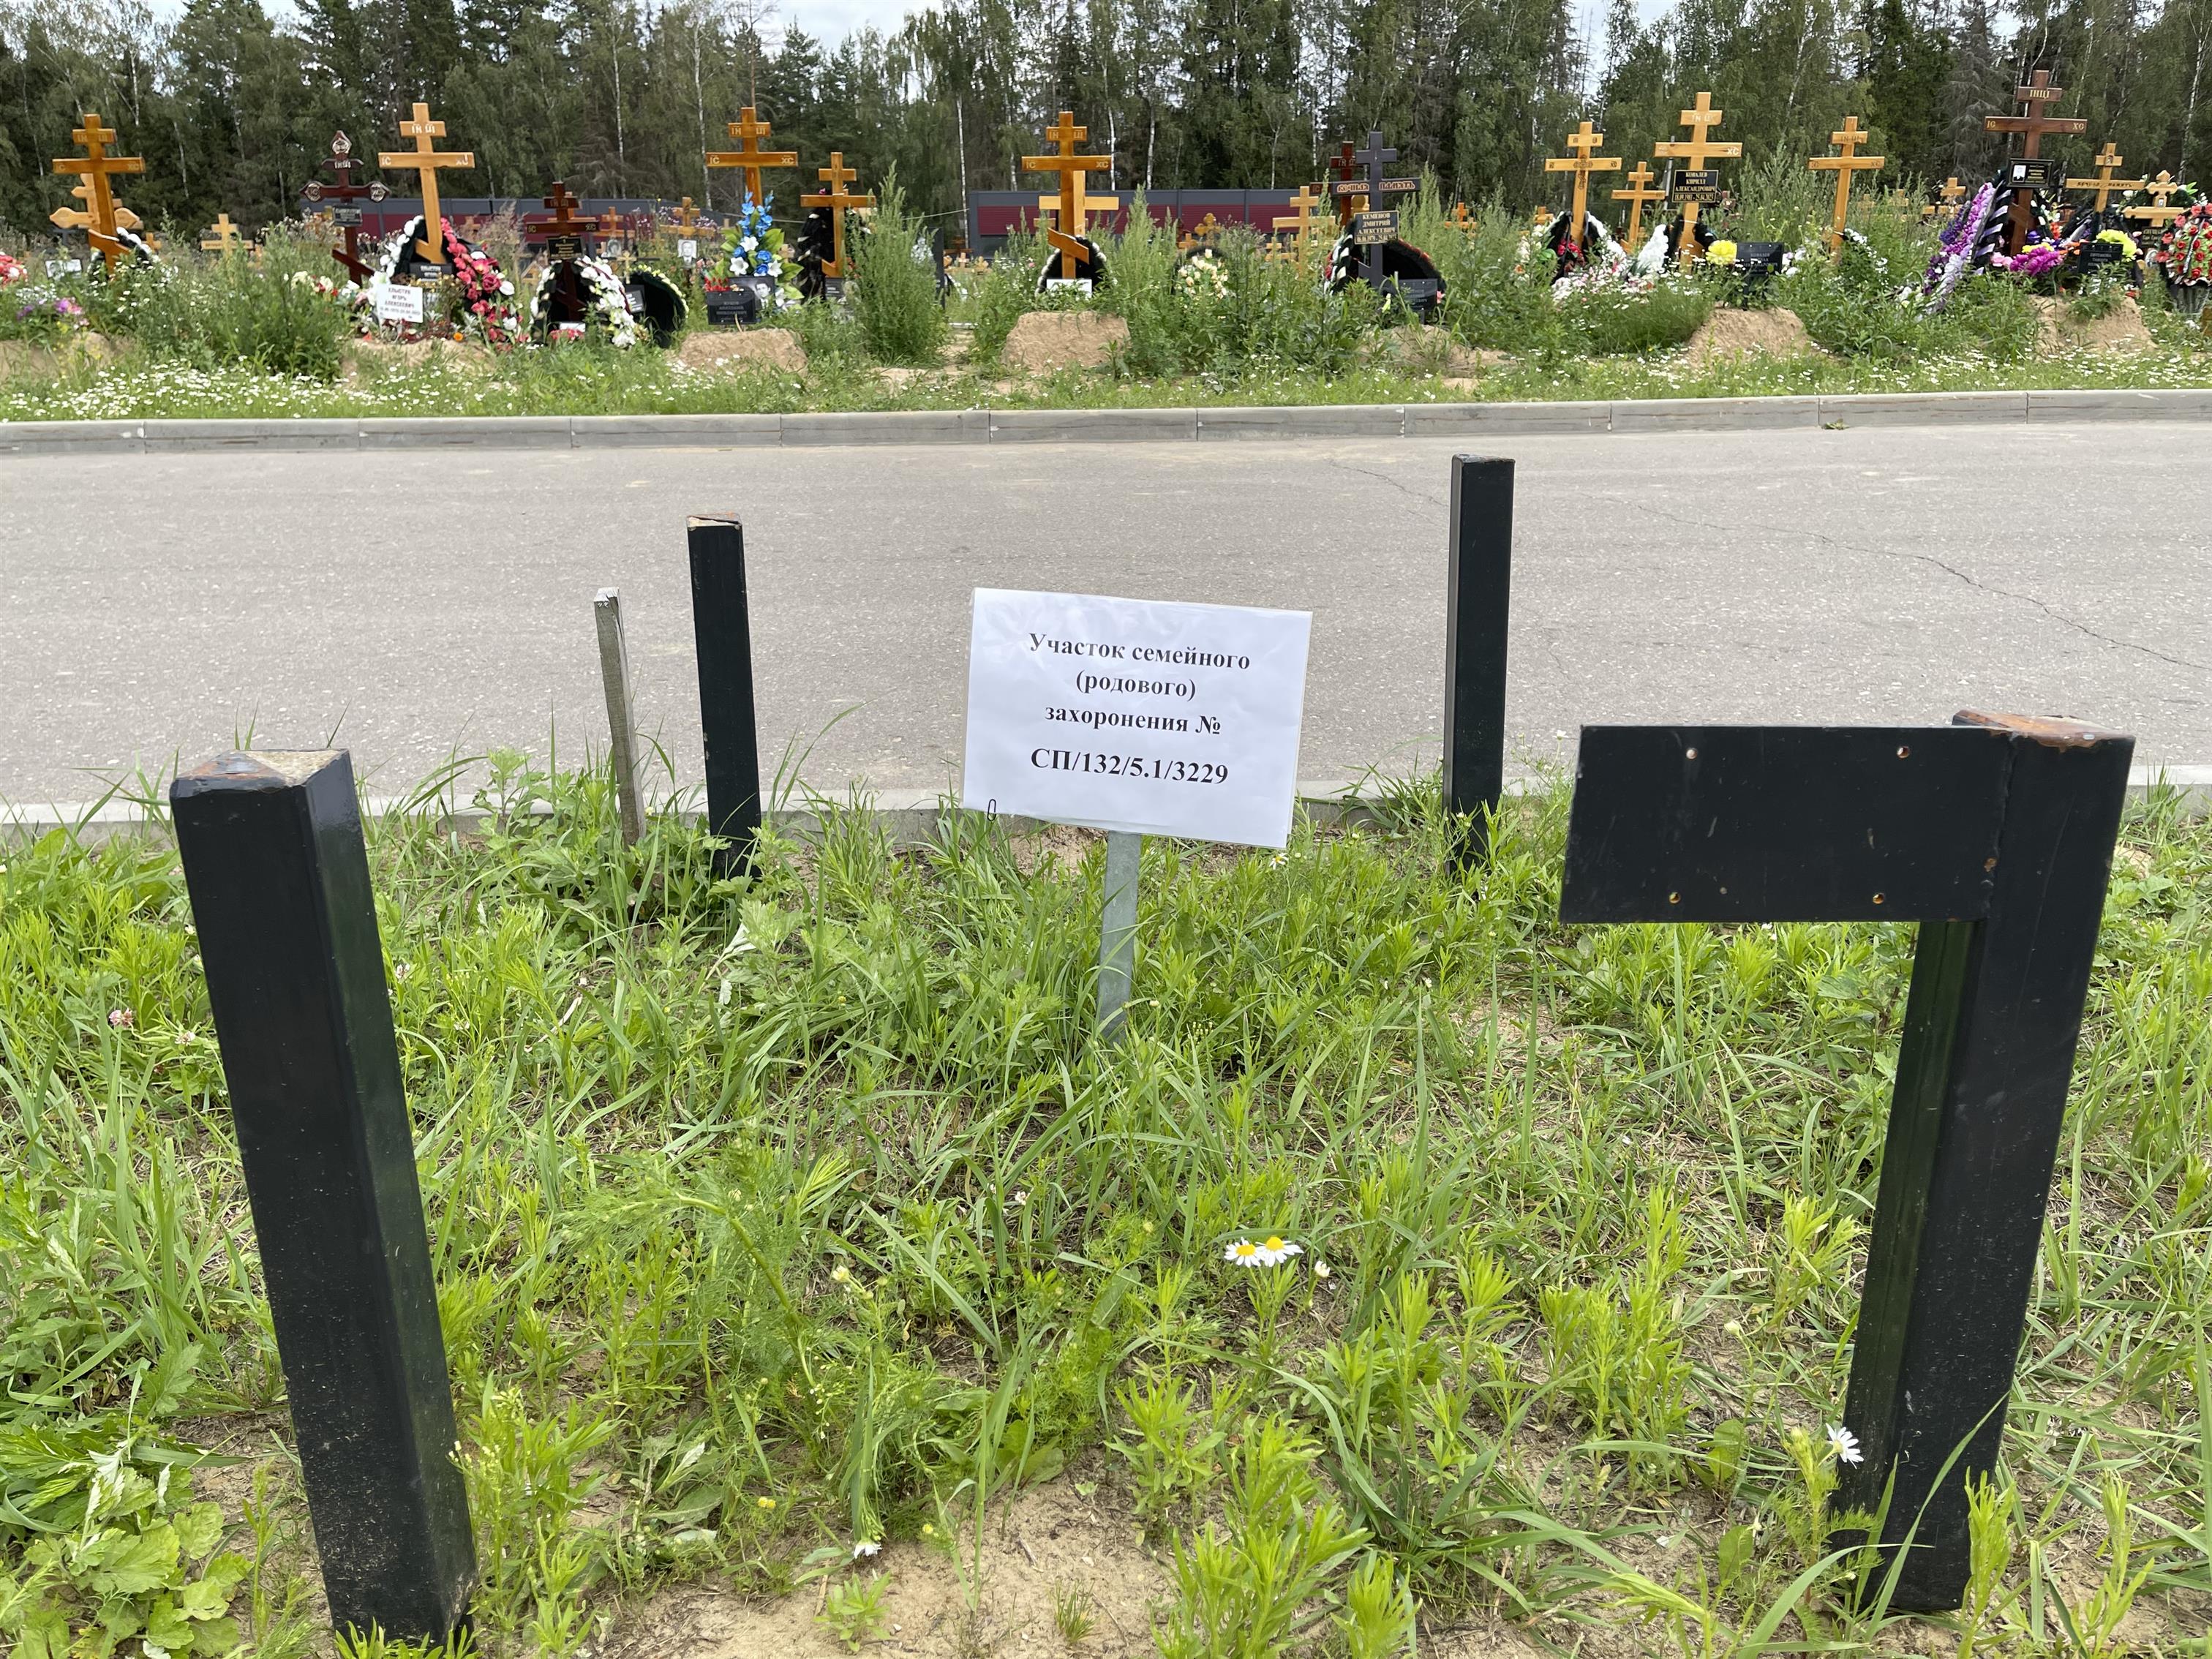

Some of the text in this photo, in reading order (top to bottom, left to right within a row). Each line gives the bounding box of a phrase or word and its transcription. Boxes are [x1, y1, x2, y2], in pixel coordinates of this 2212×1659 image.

[1029, 633, 1251, 670] Участок семейного
[1075, 669, 1197, 701] (родового)
[1045, 706, 1222, 735] захоронения №
[1031, 747, 1229, 785] СП/132/5.1/3229
